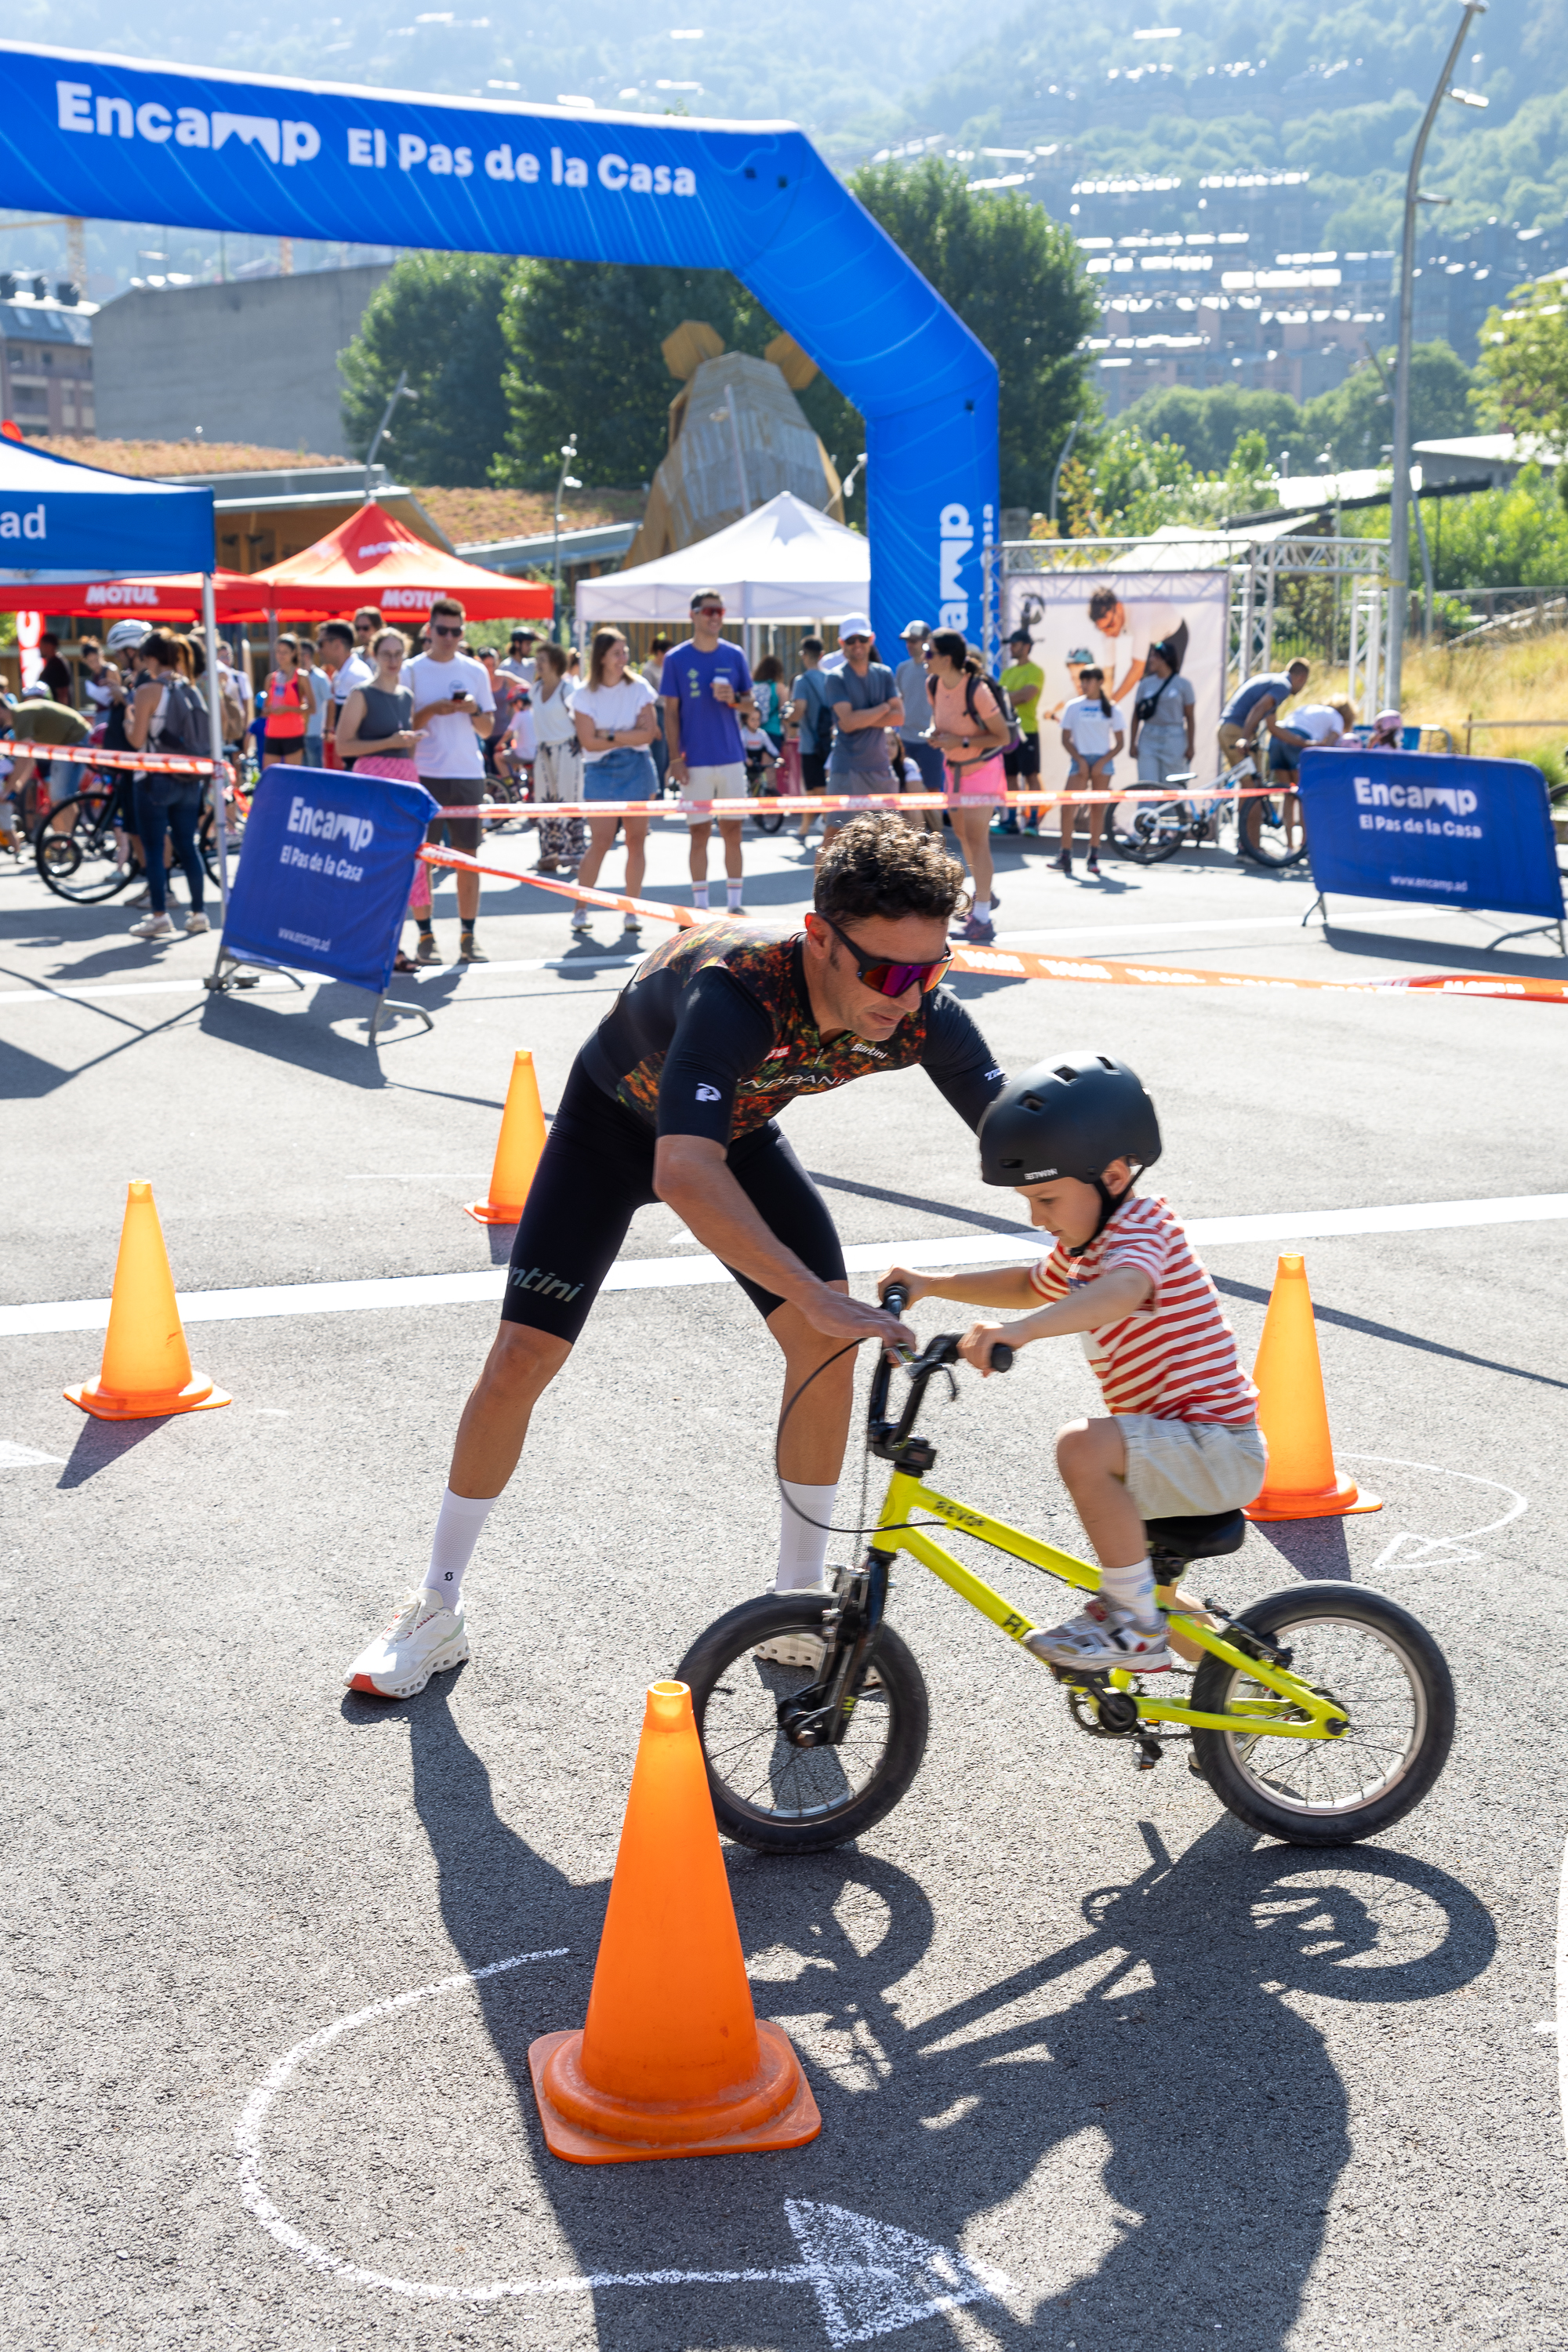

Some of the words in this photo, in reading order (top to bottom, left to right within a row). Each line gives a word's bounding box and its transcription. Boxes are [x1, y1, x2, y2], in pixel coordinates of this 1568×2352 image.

[56, 80, 321, 167] Encamp
[347, 128, 387, 169] El
[397, 132, 474, 178] Pas
[484, 143, 541, 183] de
[550, 146, 589, 187] la
[597, 153, 696, 198] Casa
[0, 503, 46, 539] ad
[85, 586, 159, 605] MOTUL
[1353, 776, 1478, 816] Encamp
[286, 796, 374, 852] Encamp
[1359, 814, 1374, 830] El
[1375, 815, 1401, 832] Pas
[1403, 817, 1424, 834] de
[1425, 818, 1442, 835] la
[1443, 820, 1483, 840] Casa
[279, 844, 293, 864] El
[290, 847, 310, 869] Pas
[309, 851, 324, 873] de
[322, 854, 336, 876] la
[336, 858, 364, 883] Casa
[1390, 876, 1468, 892] www.encamp.ad
[850, 1043, 889, 1059] santini
[737, 1074, 849, 1089] NDBAN
